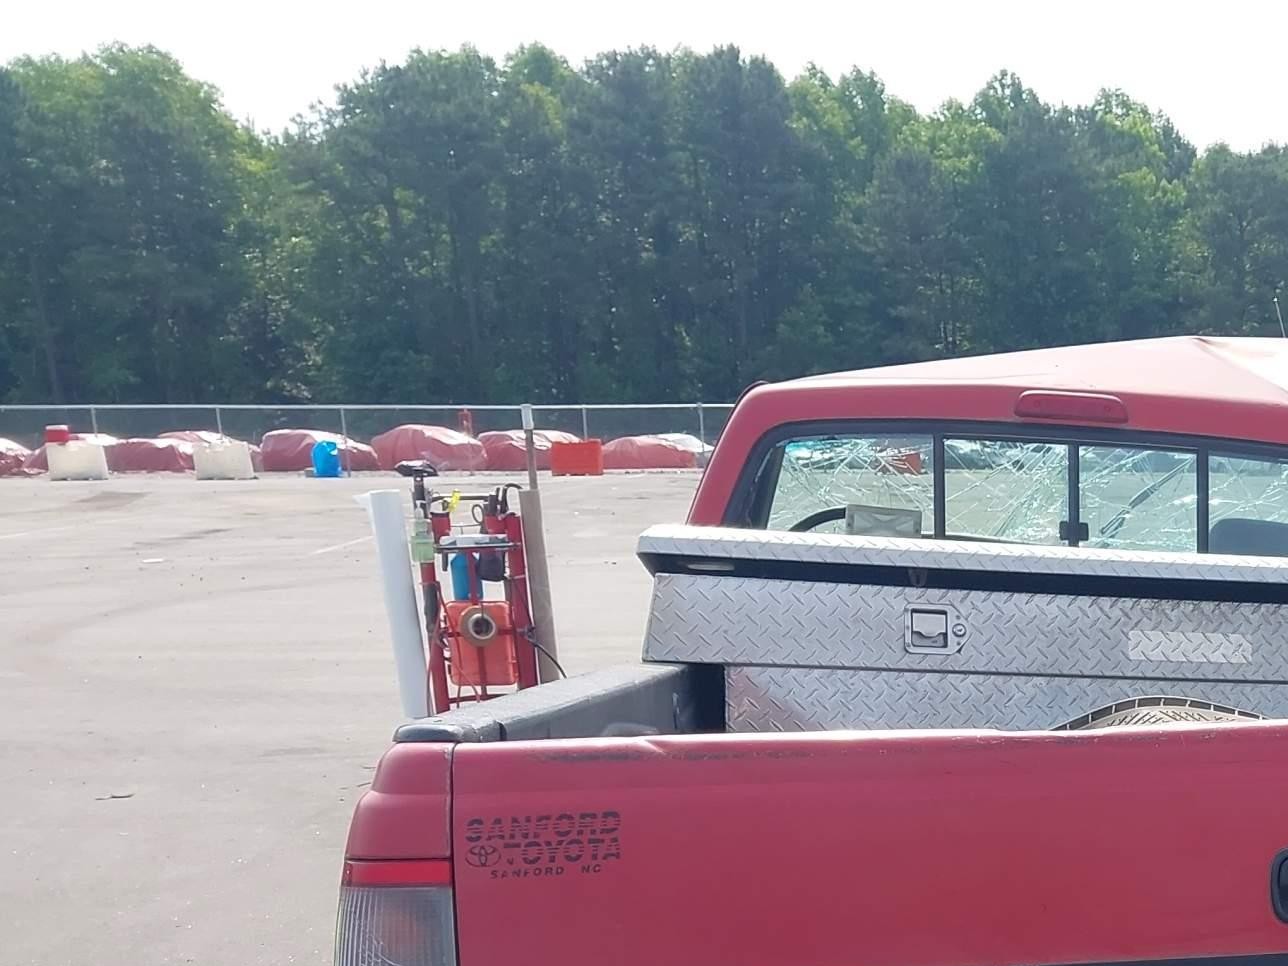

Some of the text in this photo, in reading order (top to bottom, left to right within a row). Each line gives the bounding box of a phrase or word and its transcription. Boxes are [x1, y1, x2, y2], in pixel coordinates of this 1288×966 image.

[466, 811, 621, 842] SANFORD
[503, 837, 621, 865] TOYOTA
[491, 863, 602, 880] SANFORD NC
